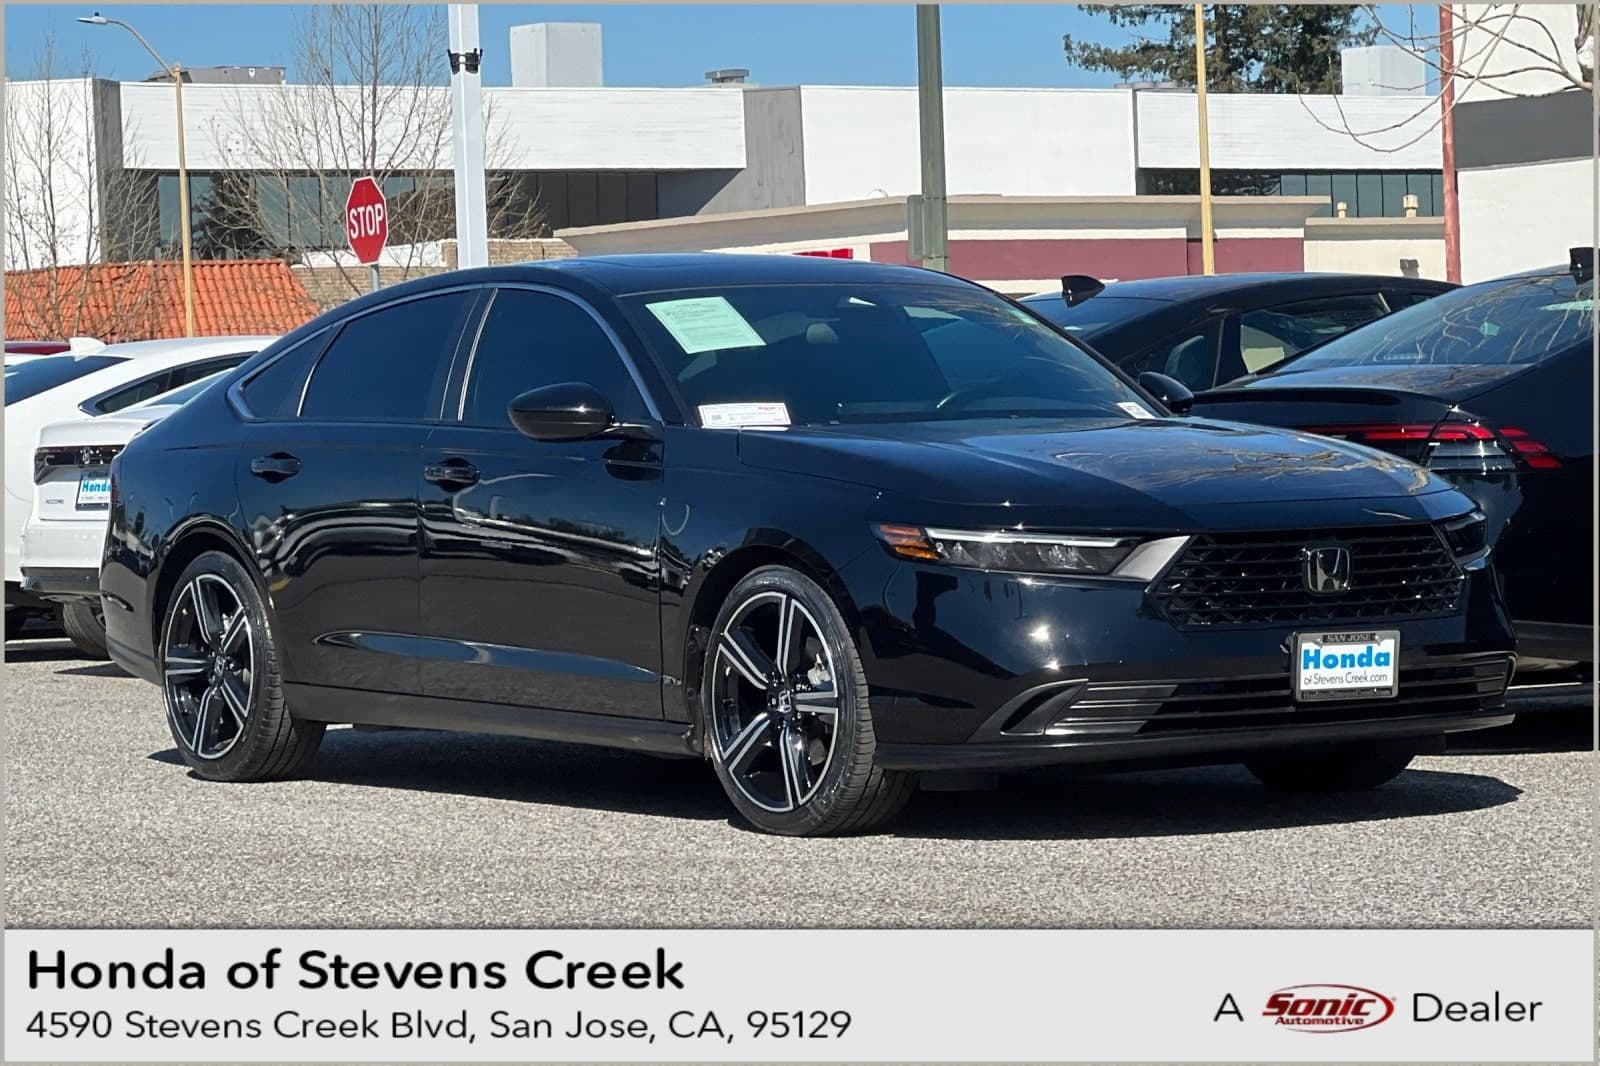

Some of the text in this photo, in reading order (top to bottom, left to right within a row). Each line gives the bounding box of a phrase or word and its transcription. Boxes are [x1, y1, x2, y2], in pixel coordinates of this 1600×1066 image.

[349, 203, 384, 240] STOP
[1327, 633, 1371, 642] SAN JOSE
[1303, 645, 1391, 670] Honda
[1303, 669, 1388, 686] of Stevens Creek.com
